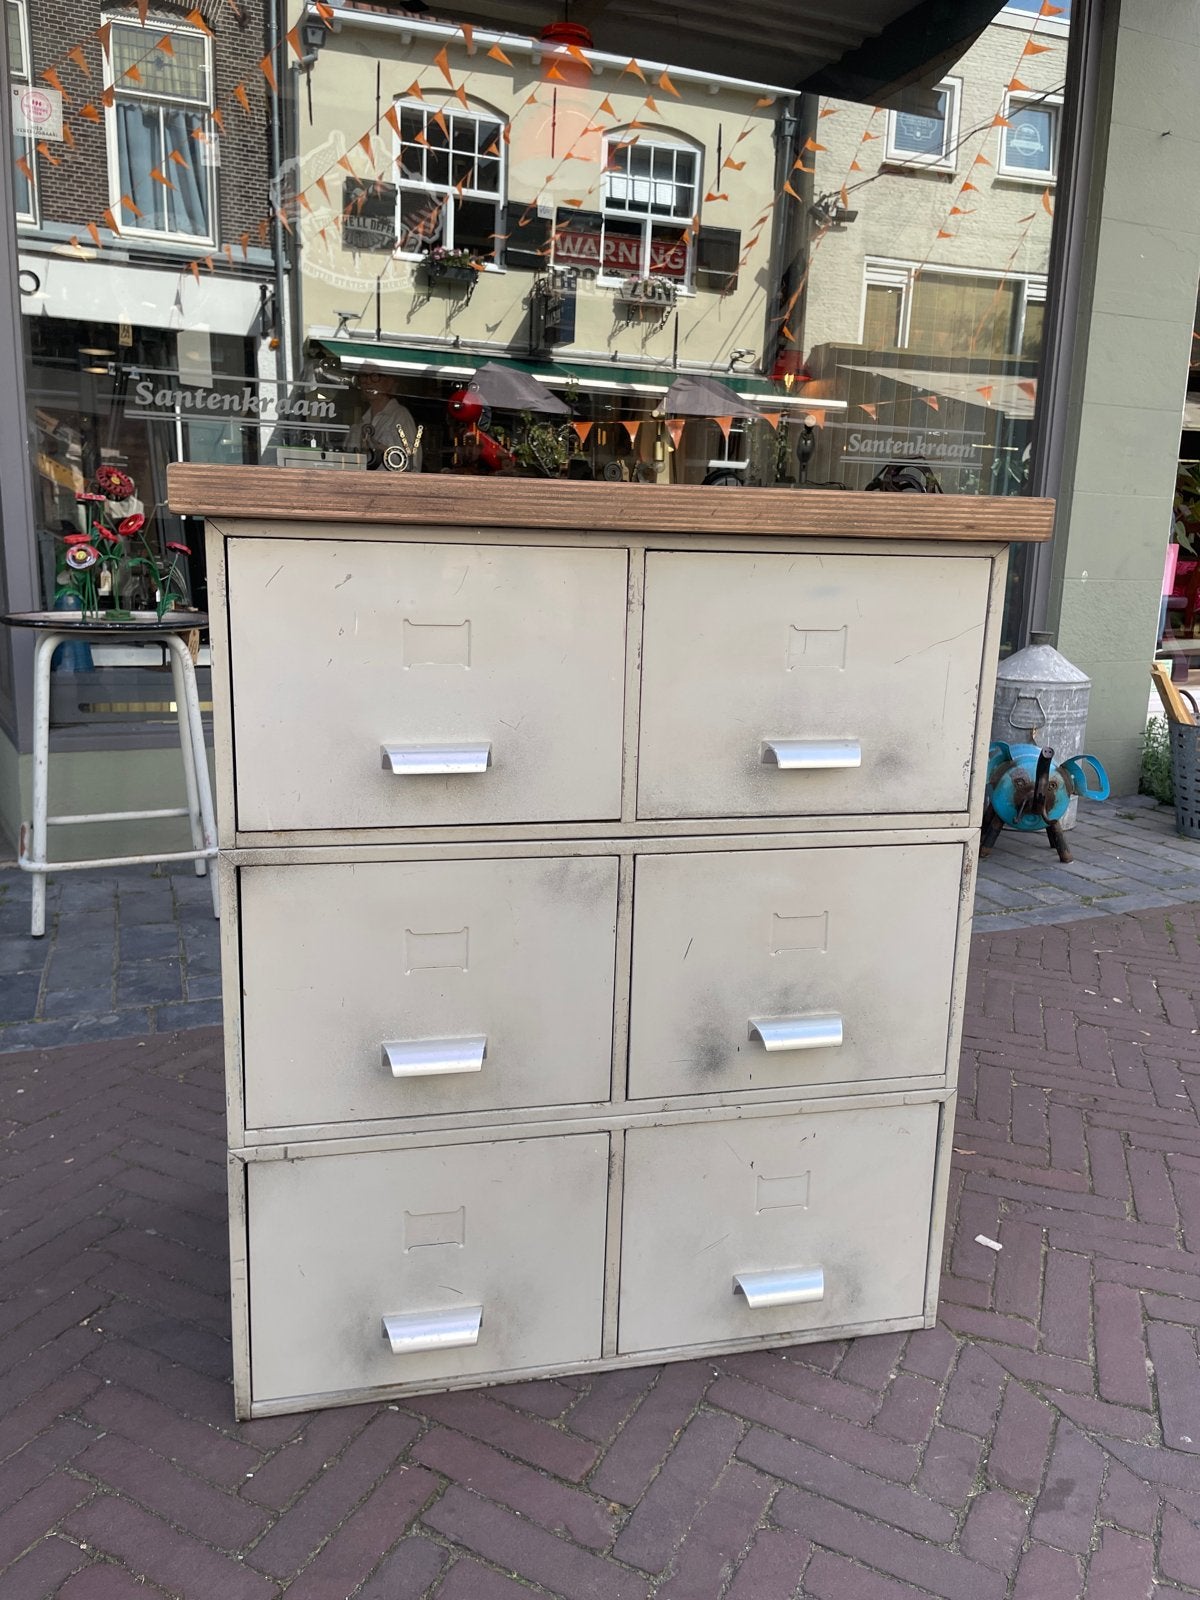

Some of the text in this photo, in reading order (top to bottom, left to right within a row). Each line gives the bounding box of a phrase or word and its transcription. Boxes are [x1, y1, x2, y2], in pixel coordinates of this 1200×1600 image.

[555, 234, 685, 271] WARNING
[135, 381, 337, 419] Santenkraam
[848, 433, 976, 458] Santenkraam
